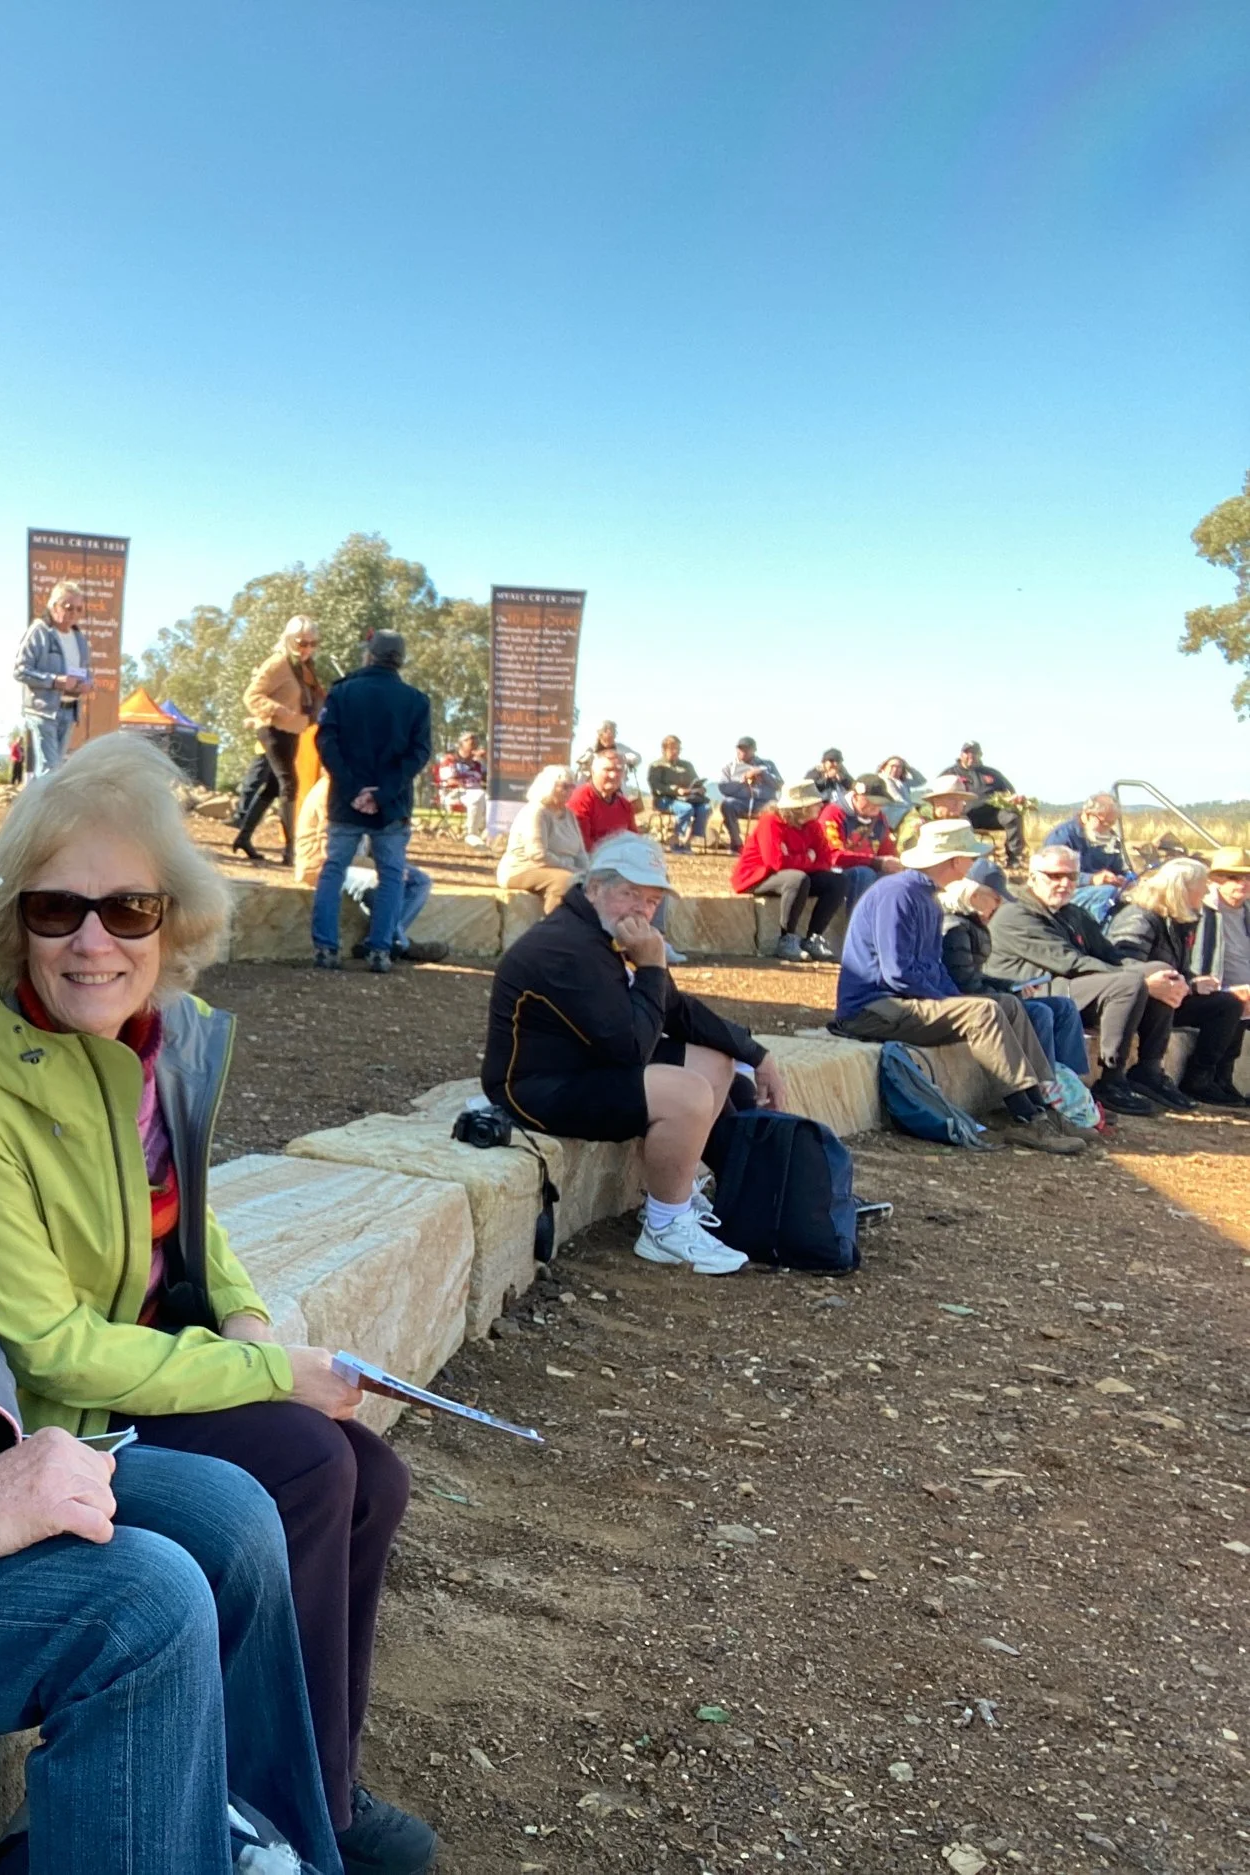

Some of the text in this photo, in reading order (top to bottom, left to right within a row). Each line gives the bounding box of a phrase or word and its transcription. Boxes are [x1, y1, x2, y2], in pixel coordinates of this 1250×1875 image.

[33, 535, 64, 546] MYALL
[103, 541, 125, 551] 1838
[32, 560, 123, 578] On 10 June 1838
[496, 592, 525, 601] MYALL
[86, 599, 107, 611] eek
[496, 710, 523, 724] Myall
